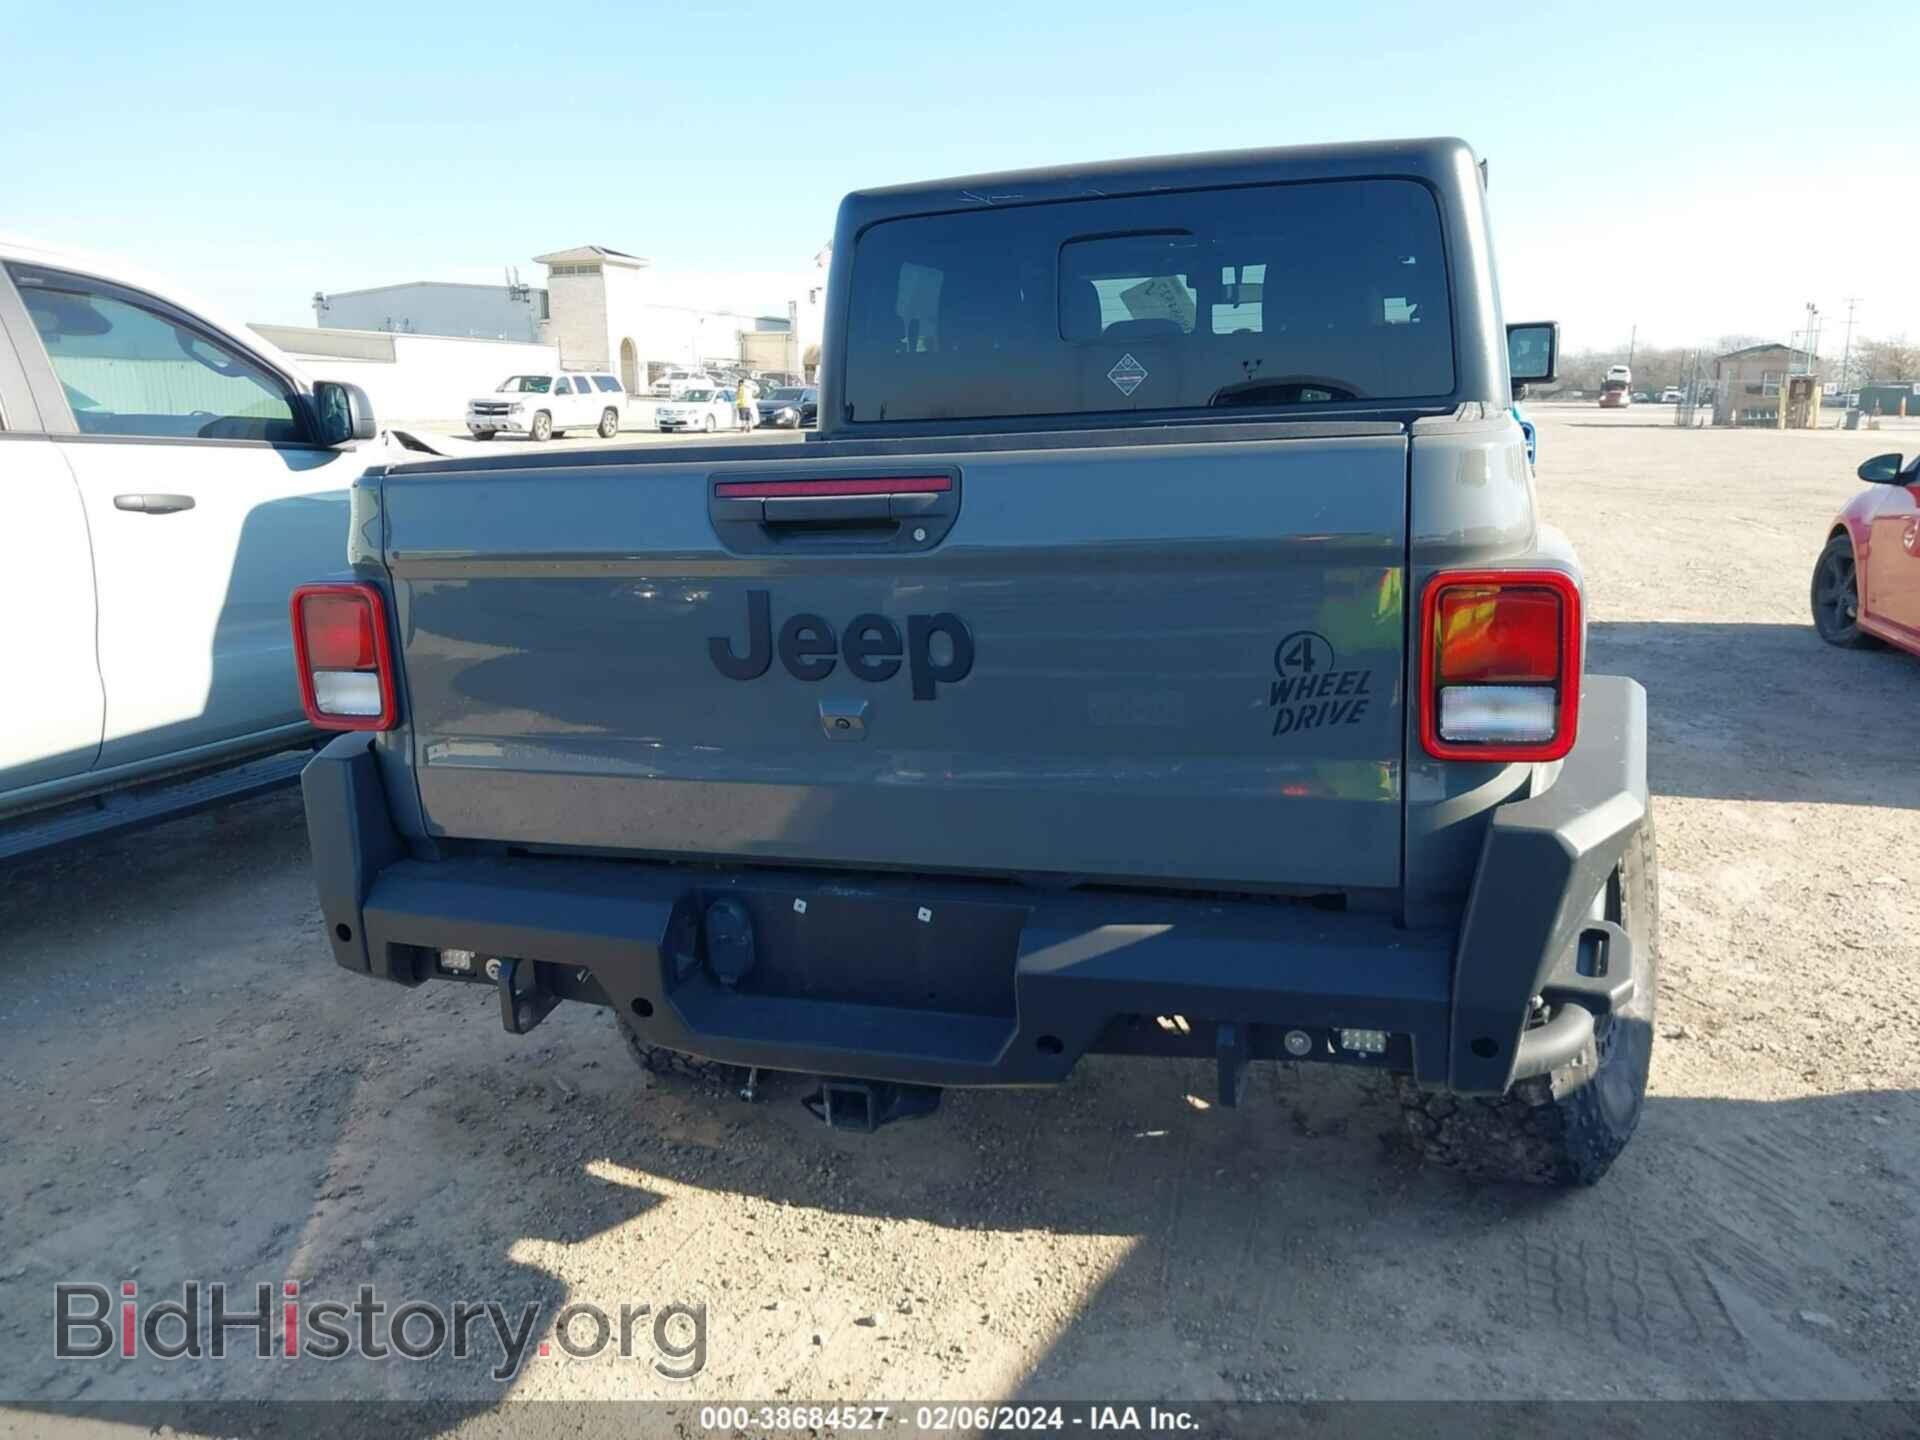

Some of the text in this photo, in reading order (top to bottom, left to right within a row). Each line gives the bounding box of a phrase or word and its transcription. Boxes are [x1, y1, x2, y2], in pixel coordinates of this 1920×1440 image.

[707, 589, 975, 701] Jeep
[1283, 638, 1316, 673] 4
[1270, 670, 1373, 707] WHEEL
[1272, 699, 1369, 736] DRIVE
